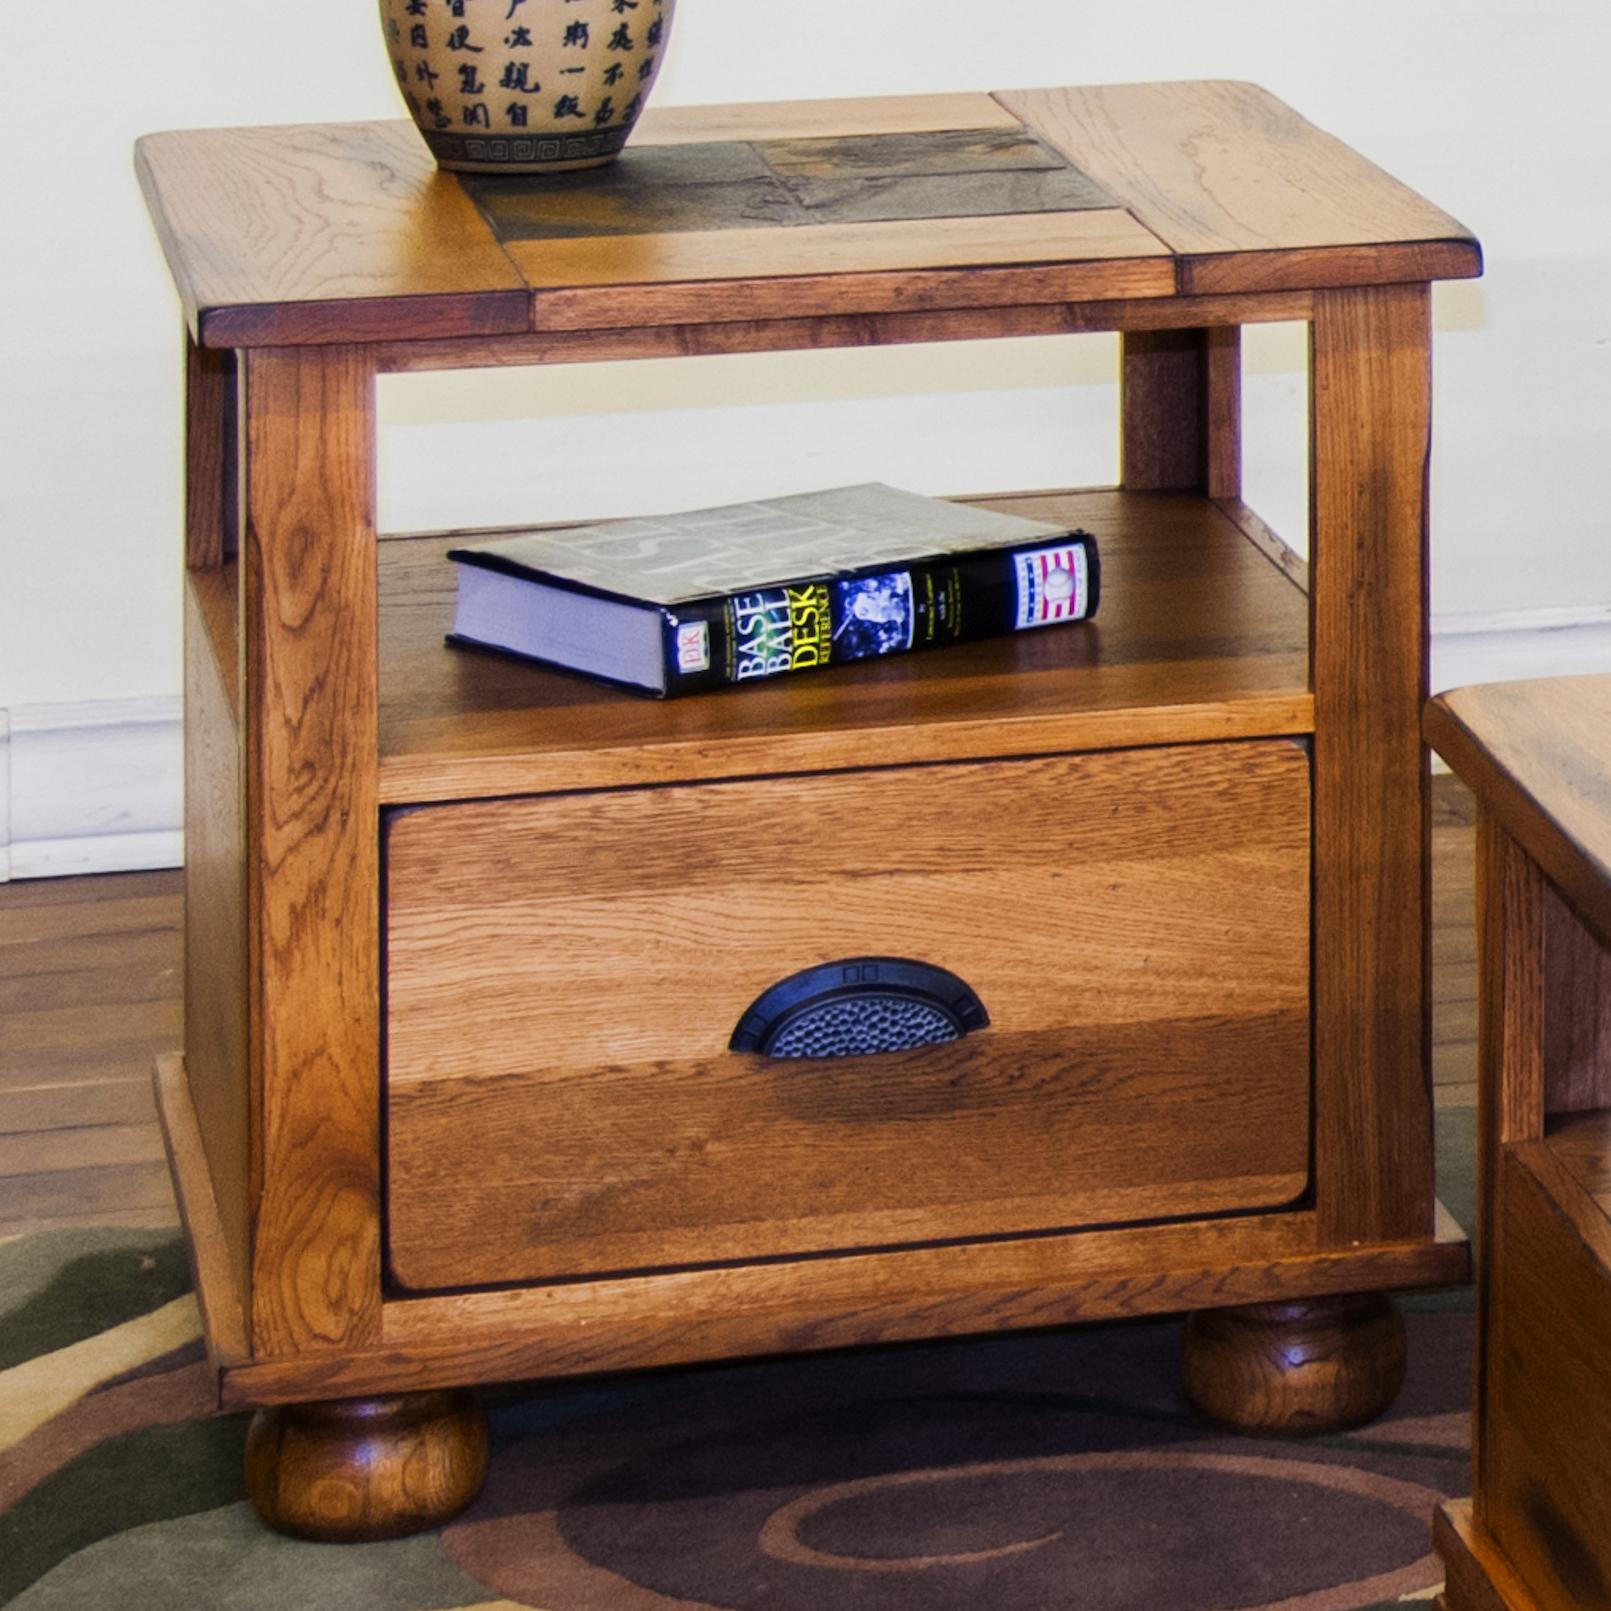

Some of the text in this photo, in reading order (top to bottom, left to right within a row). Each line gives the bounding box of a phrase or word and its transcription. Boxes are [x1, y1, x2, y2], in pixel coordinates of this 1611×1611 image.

[683, 631, 701, 664] DK
[736, 594, 767, 680] BASE
[766, 589, 793, 674] BALL
[790, 585, 820, 670] DESK
